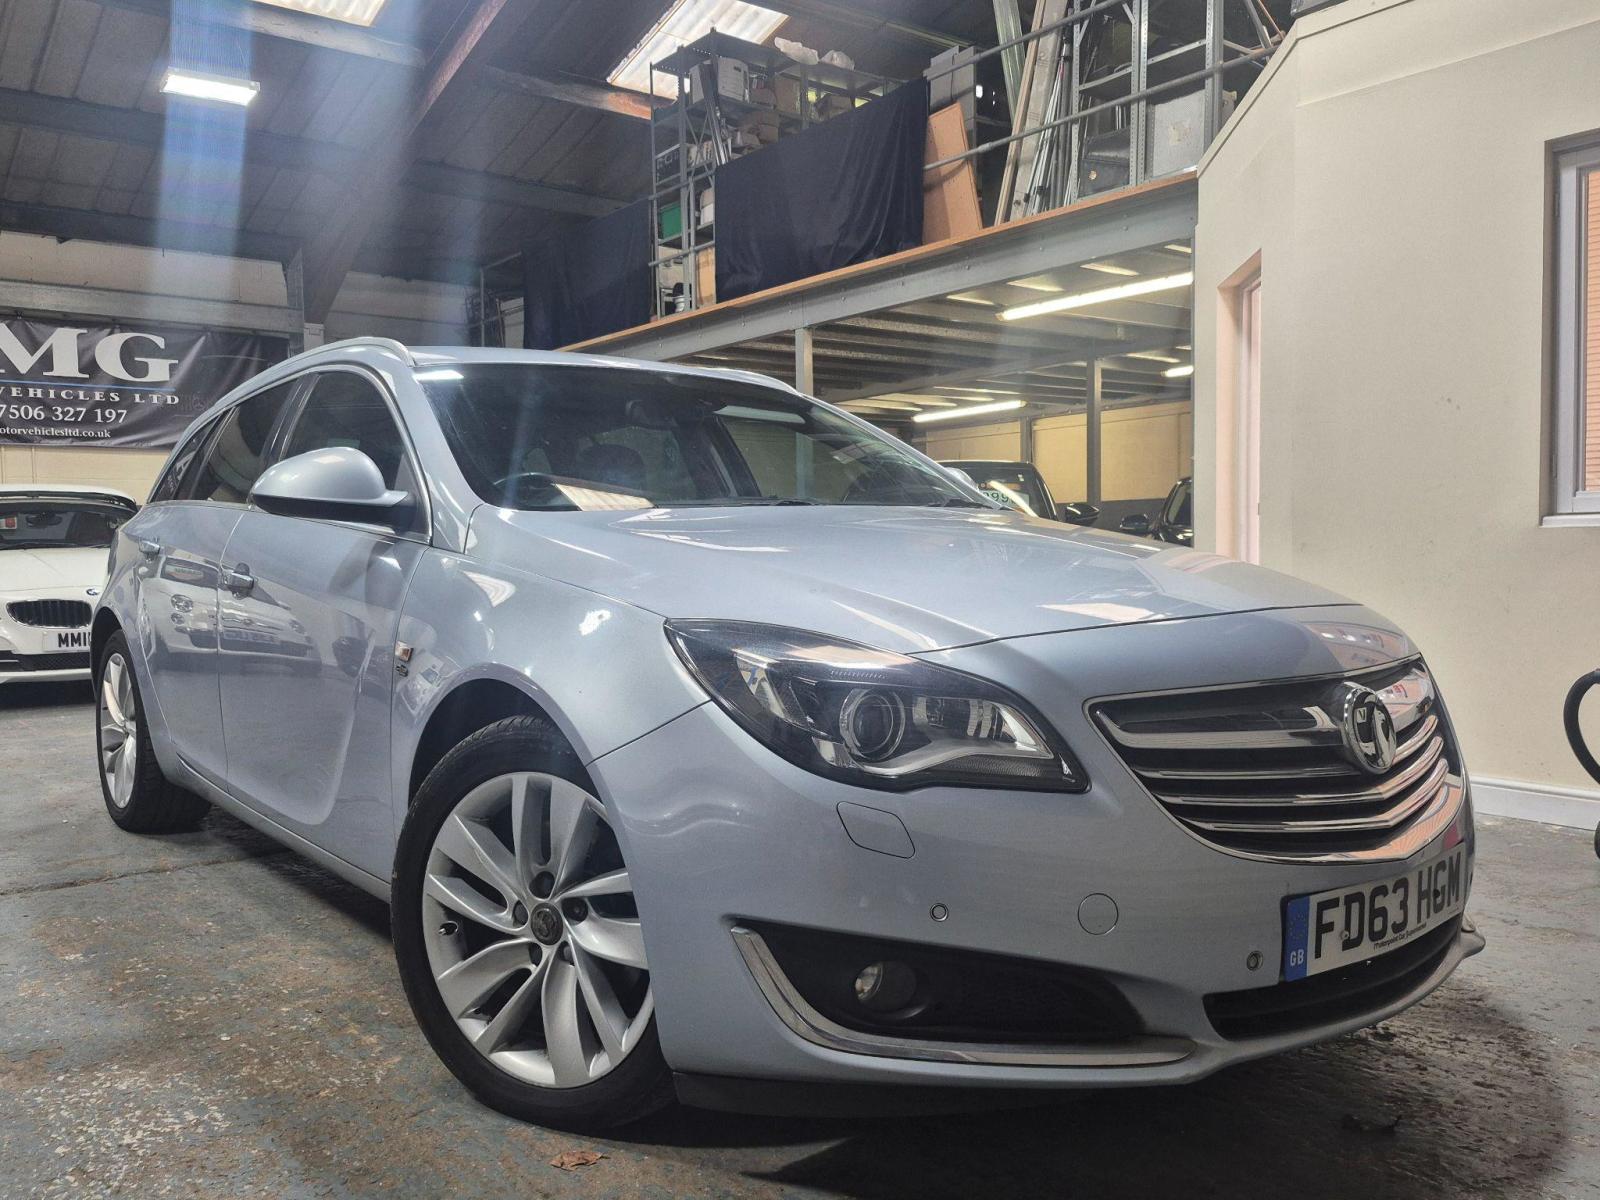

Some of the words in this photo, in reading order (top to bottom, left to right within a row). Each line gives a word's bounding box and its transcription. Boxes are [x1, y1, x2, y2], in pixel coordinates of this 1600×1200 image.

[134, 393, 180, 405] LTD
[52, 406, 87, 422] 327
[94, 409, 127, 424] 197
[1314, 876, 1409, 960] FD63
[1416, 851, 1461, 925] HGM
[1289, 948, 1304, 967] GB
